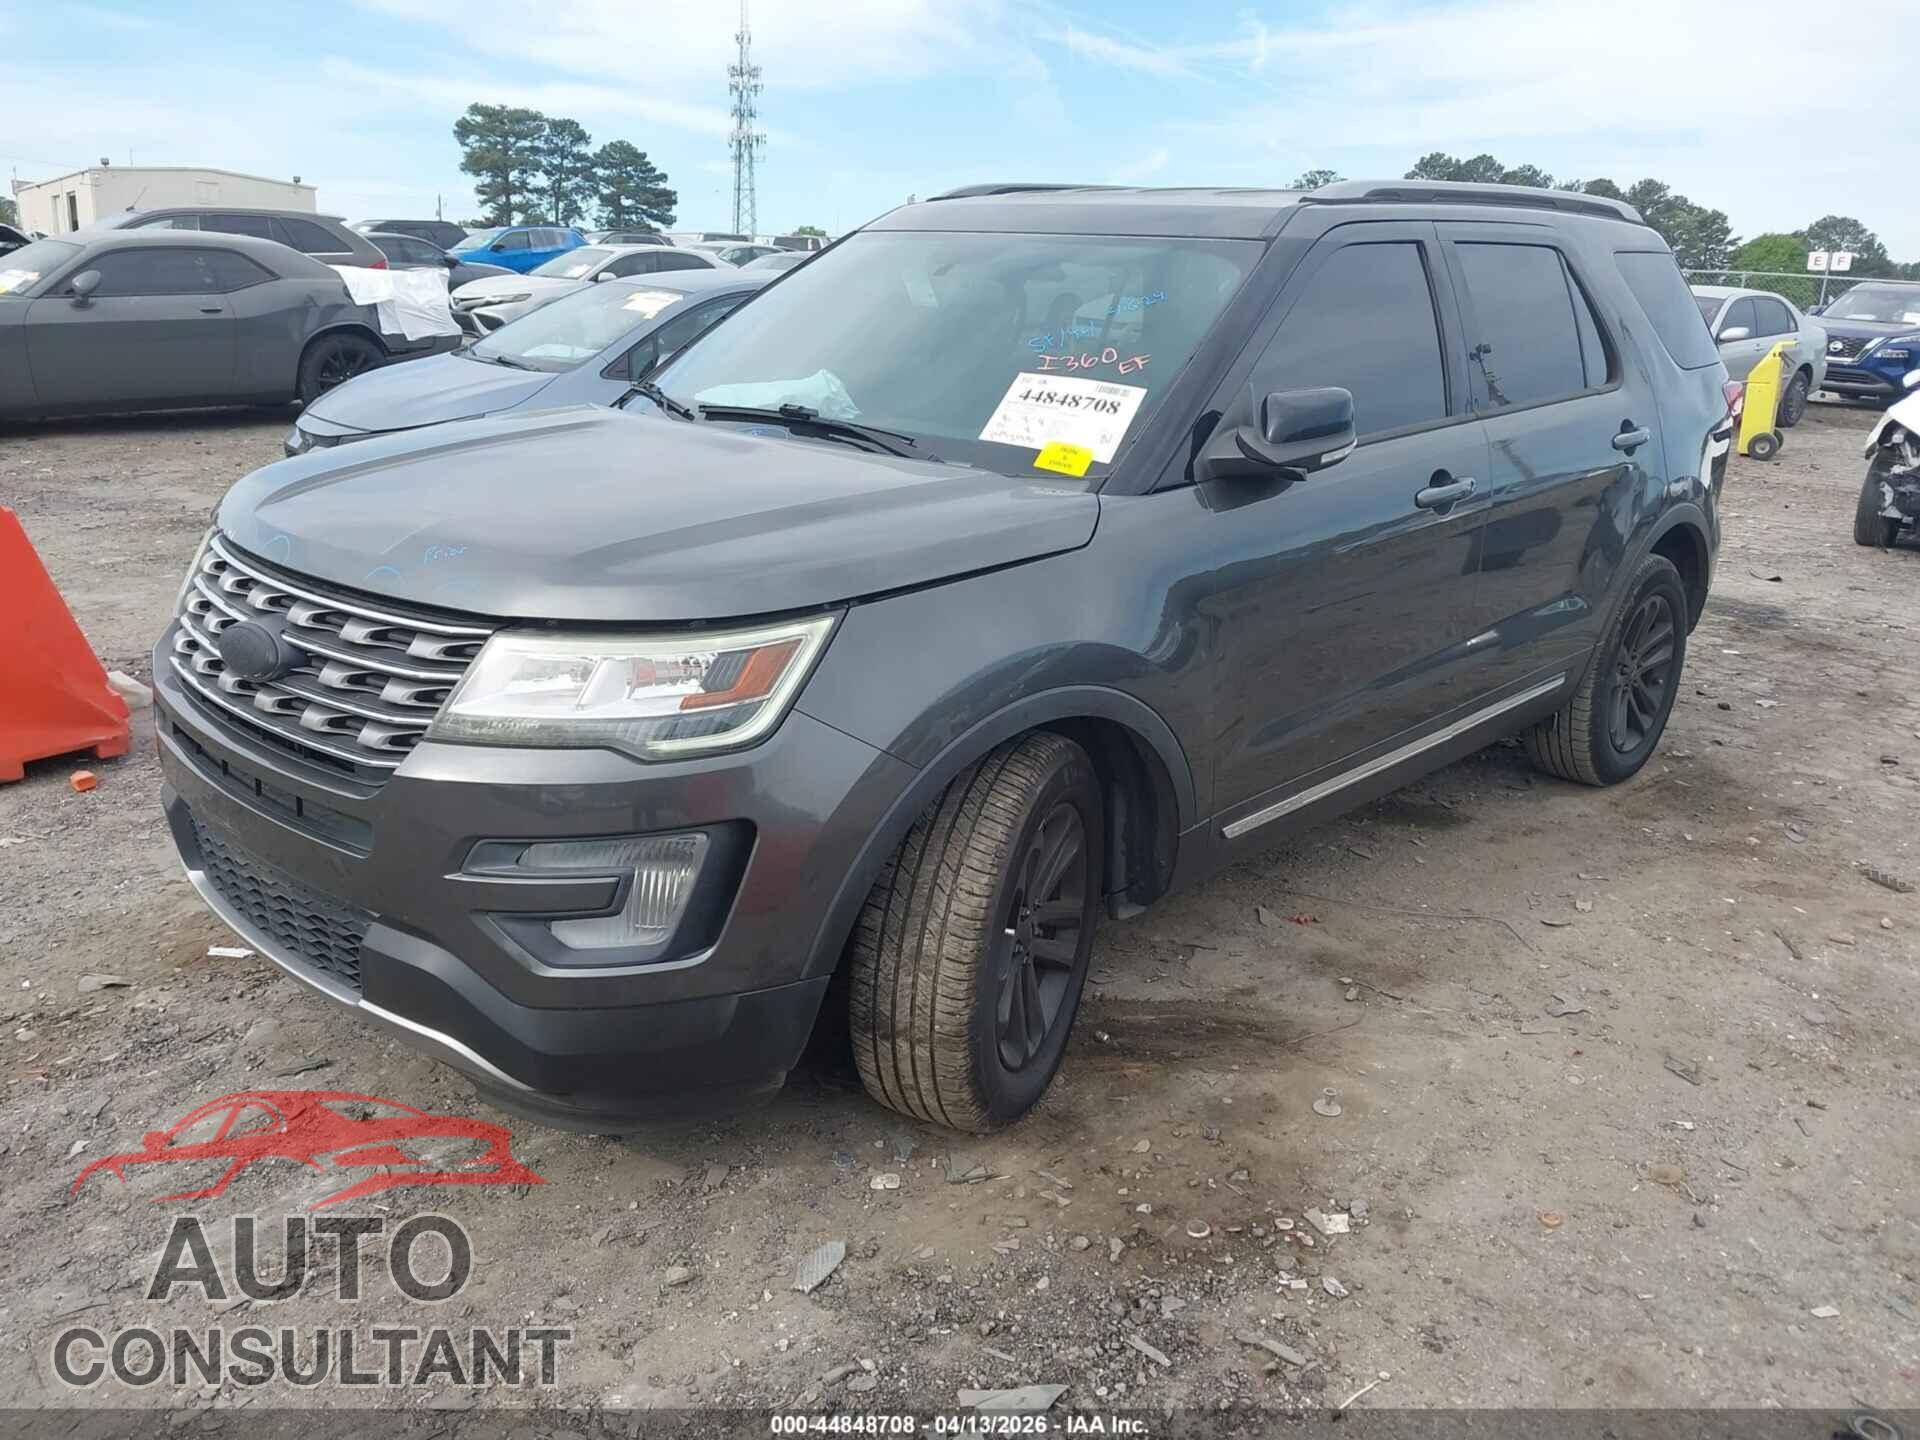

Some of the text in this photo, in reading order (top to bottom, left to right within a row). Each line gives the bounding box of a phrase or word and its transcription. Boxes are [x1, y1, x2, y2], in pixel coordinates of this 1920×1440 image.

[1813, 255, 1824, 266] E
[1837, 256, 1848, 266] F
[1018, 388, 1122, 415] 44848708
